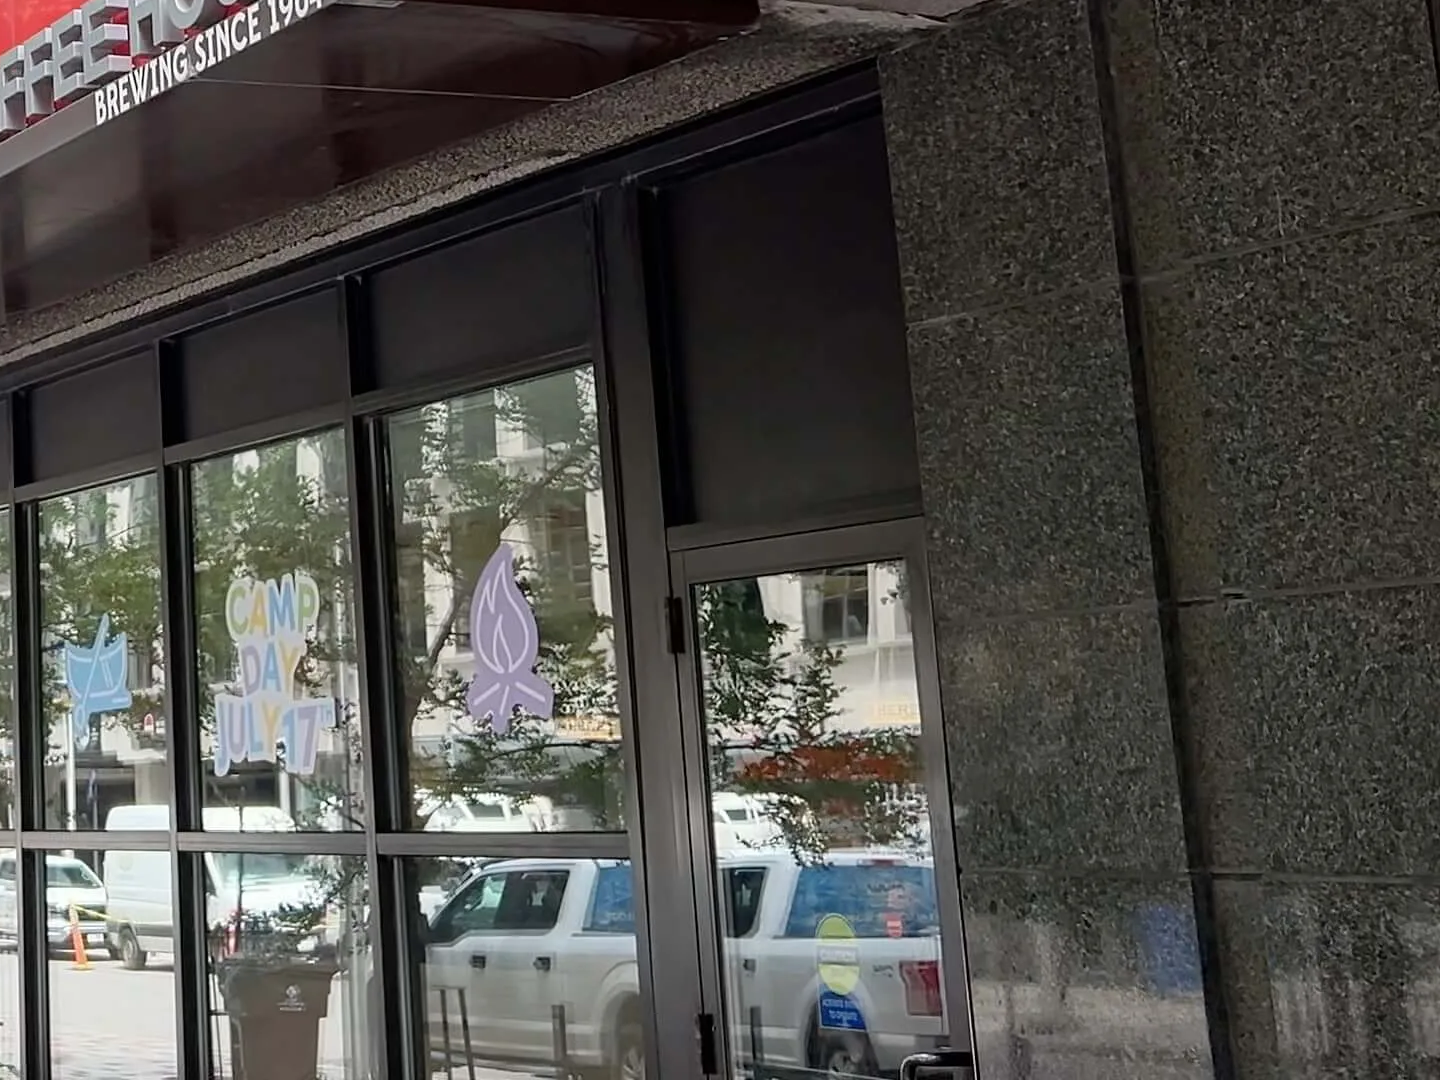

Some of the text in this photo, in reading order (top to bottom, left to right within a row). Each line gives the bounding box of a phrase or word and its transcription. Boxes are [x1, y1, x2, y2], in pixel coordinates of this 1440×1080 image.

[94, 44, 190, 126] BREWING
[194, 2, 262, 72] SINCE
[226, 576, 319, 638] CAMP
[240, 639, 300, 698] DAY
[216, 700, 278, 772] JULY
